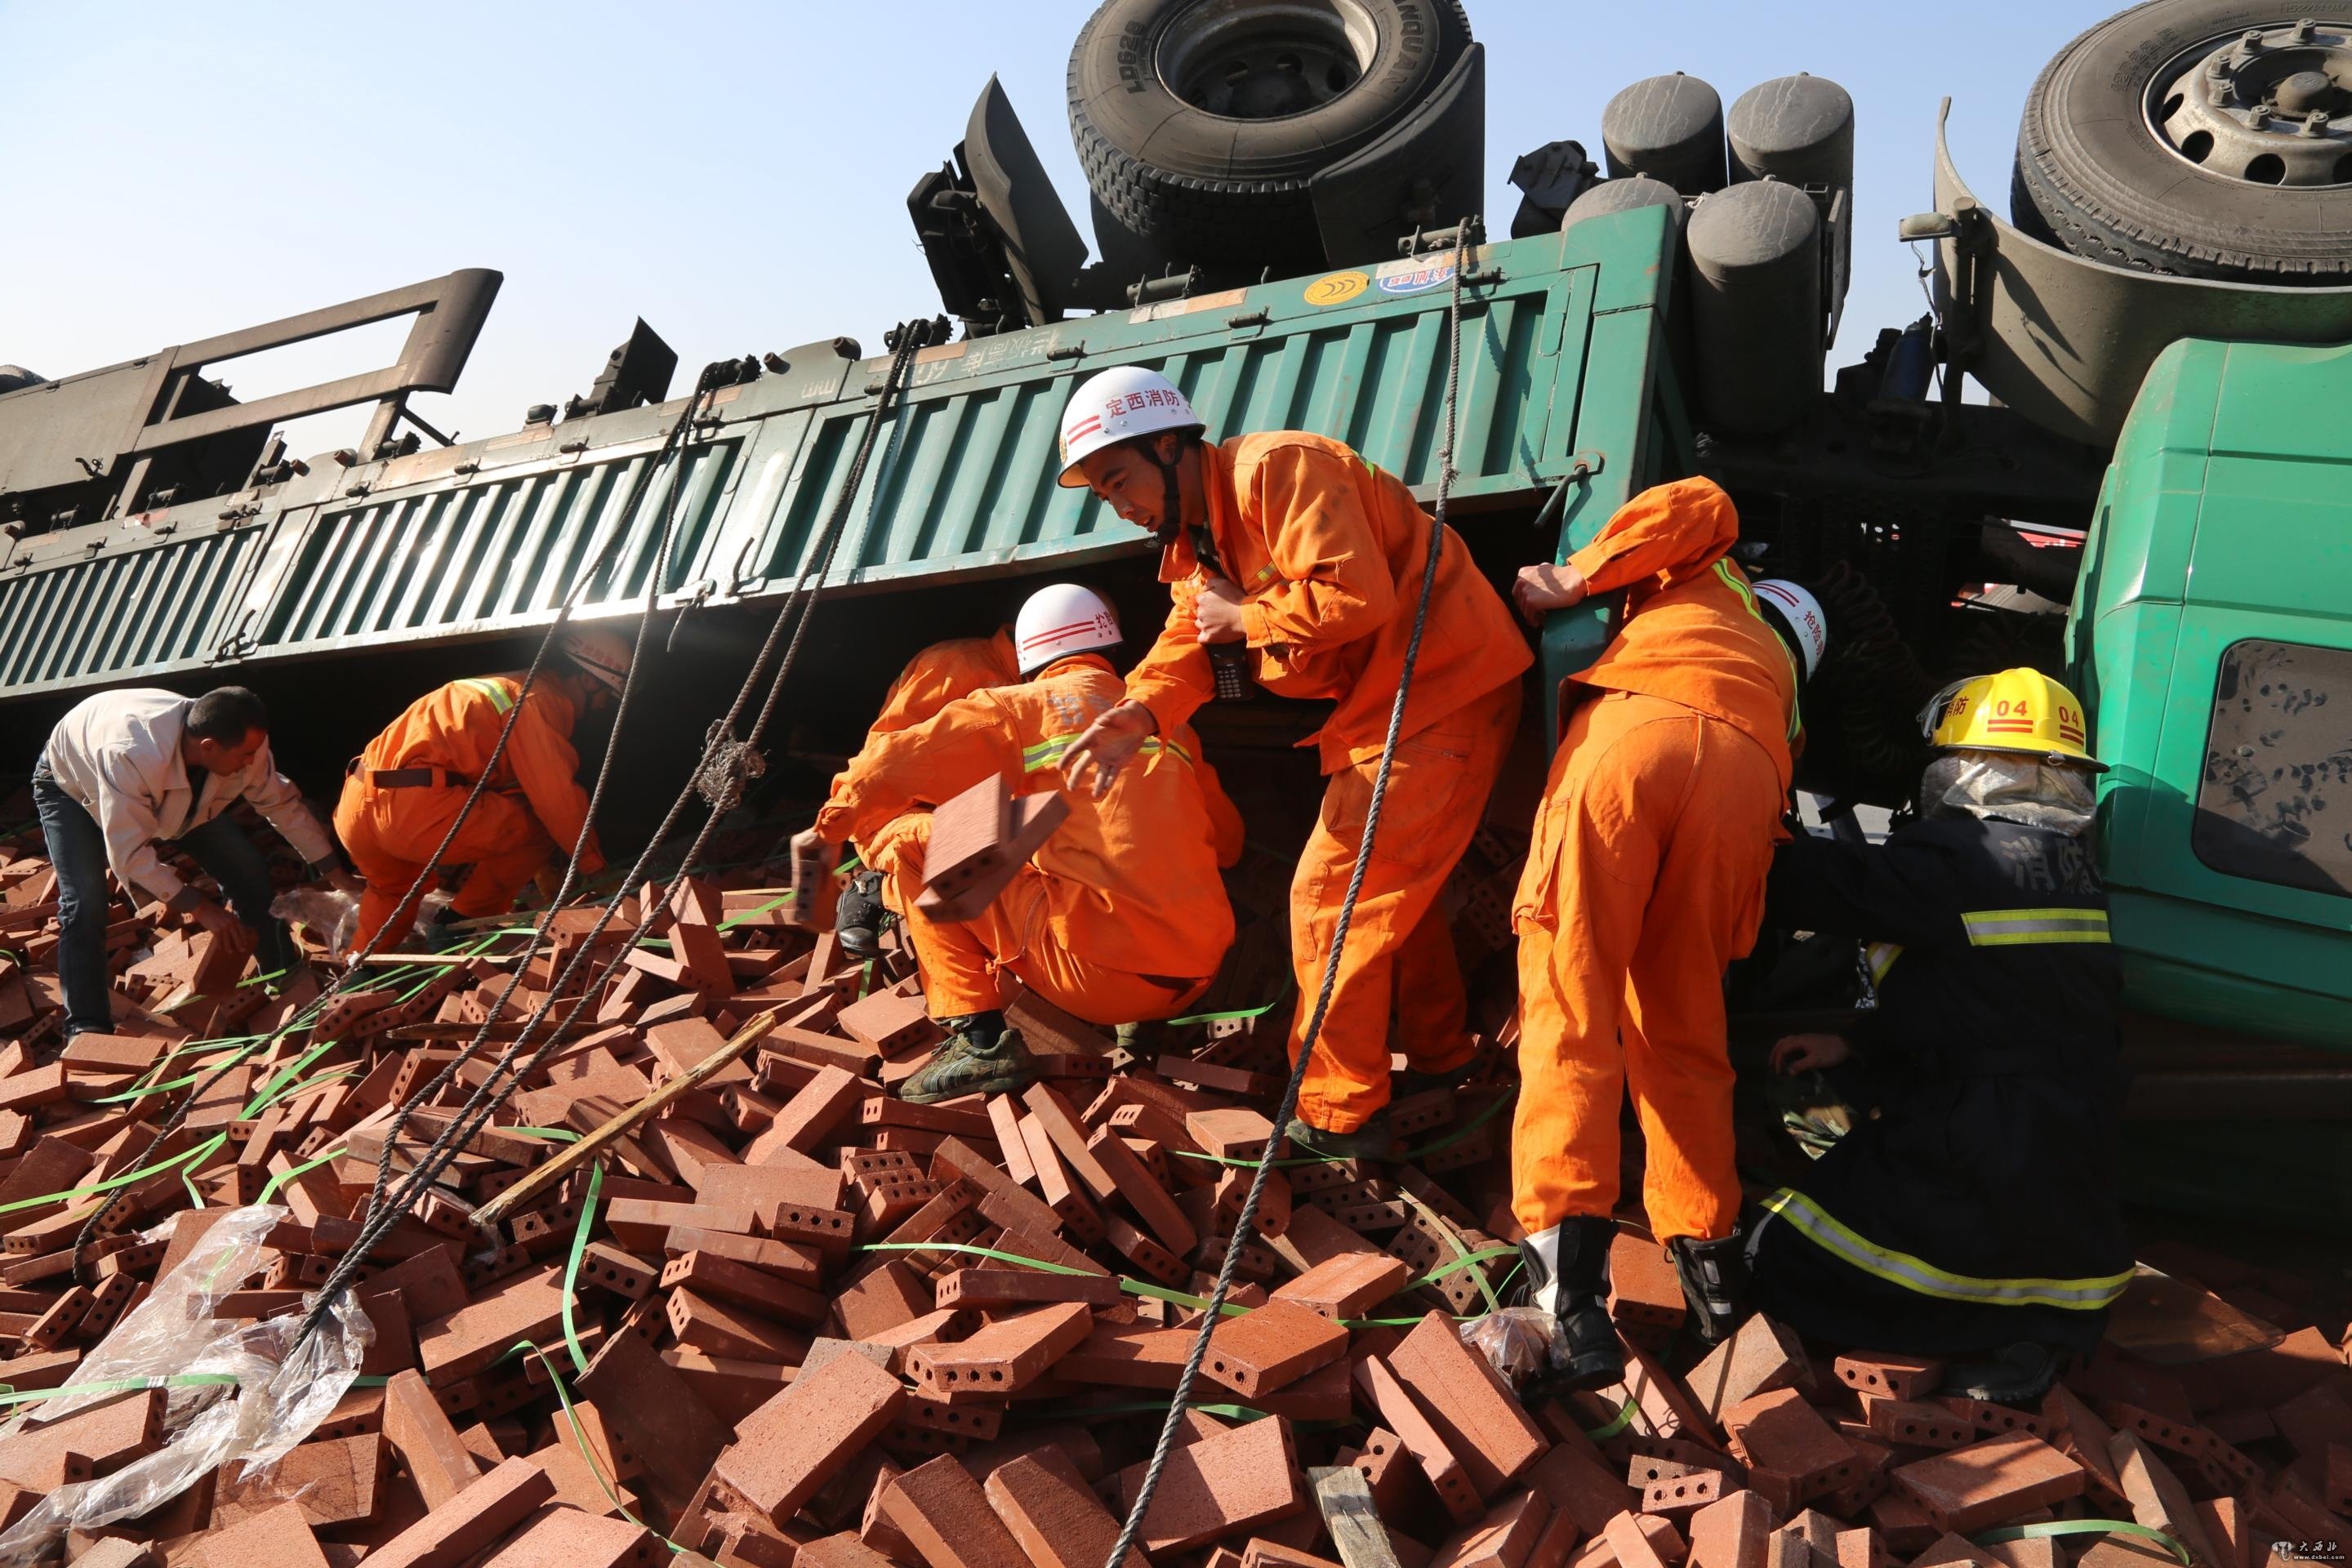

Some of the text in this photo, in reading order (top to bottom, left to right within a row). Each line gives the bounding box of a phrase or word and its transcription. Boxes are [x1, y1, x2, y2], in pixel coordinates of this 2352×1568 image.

[1105, 389, 1180, 418] 定西消防
[1997, 700, 2028, 716] 04
[2059, 706, 2079, 728] 04
